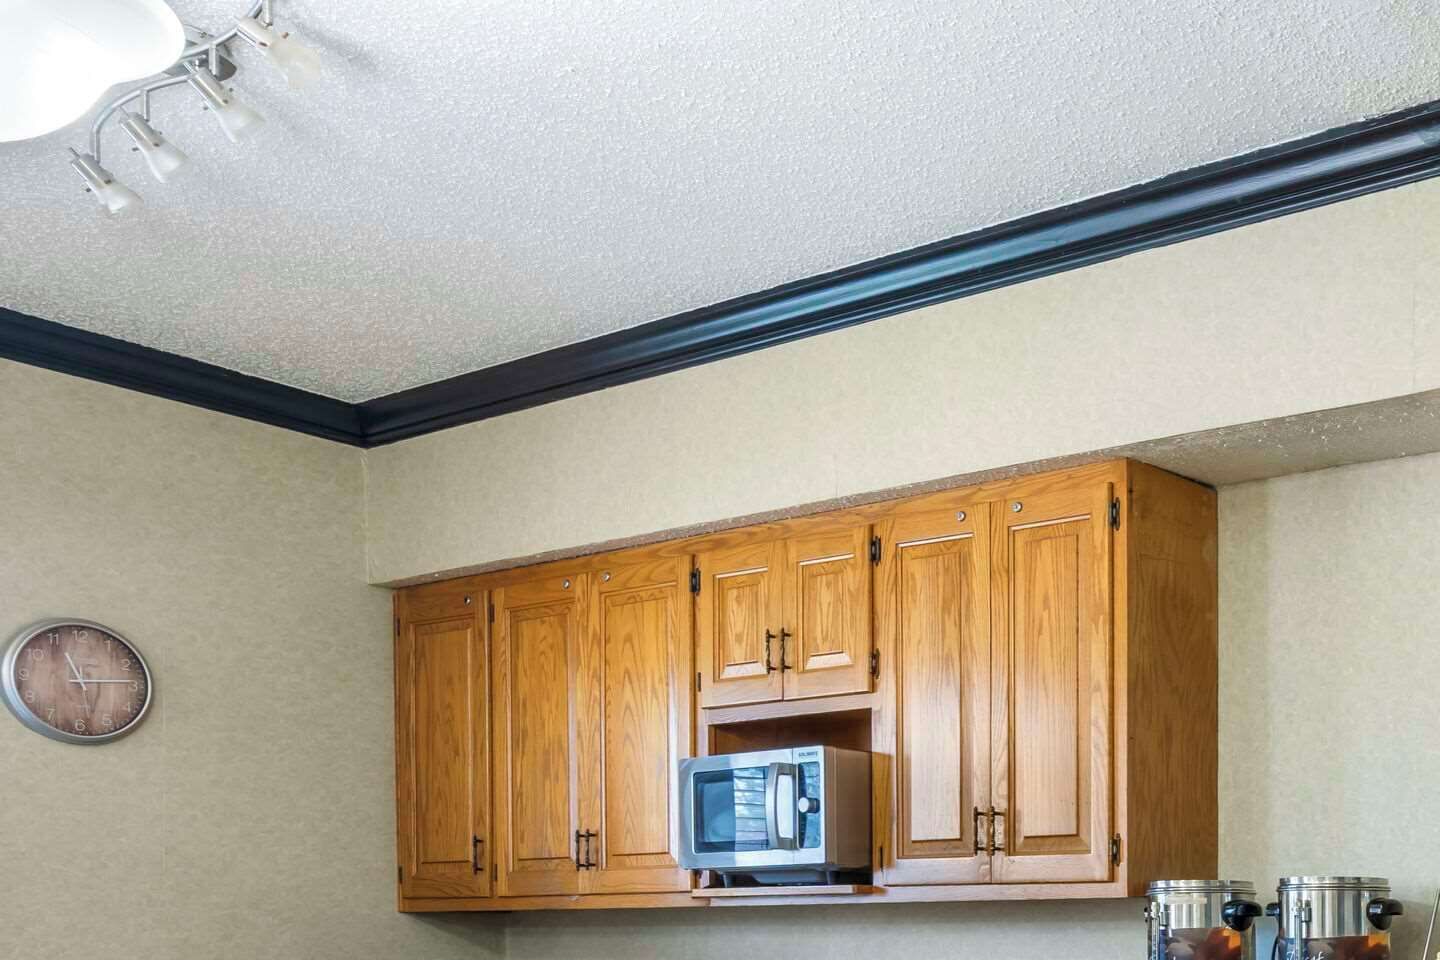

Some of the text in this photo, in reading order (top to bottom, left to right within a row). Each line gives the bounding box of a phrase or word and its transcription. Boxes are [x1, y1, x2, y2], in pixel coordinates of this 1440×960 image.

[48, 633, 59, 645] 11
[72, 630, 89, 643] 12
[104, 639, 111, 652] 1
[27, 648, 44, 661] 10
[120, 658, 130, 672] 2
[18, 668, 29, 681] 9
[129, 680, 138, 692] 3
[25, 691, 35, 703] 8
[47, 708, 56, 721] 7
[102, 714, 112, 726] 5
[74, 719, 86, 731] 6
